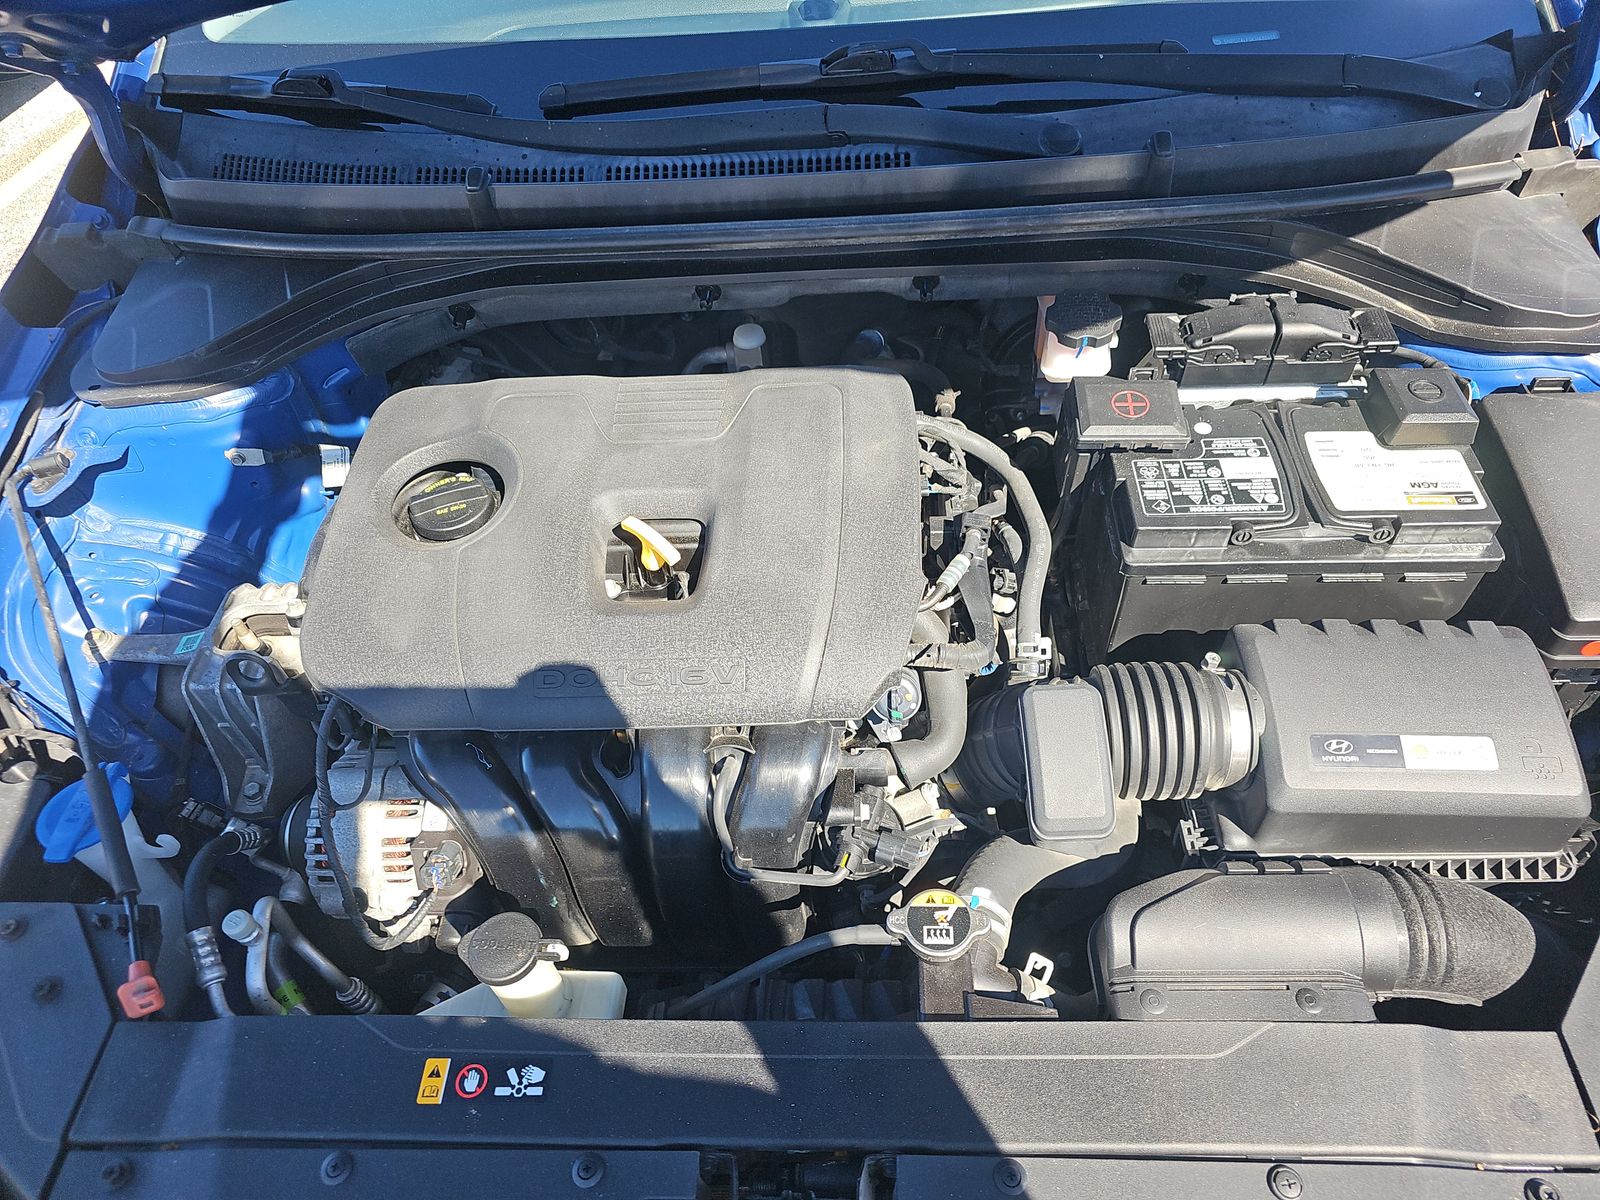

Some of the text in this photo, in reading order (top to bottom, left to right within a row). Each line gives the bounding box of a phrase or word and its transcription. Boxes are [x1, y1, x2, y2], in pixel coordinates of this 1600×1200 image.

[535, 664, 741, 689] DOHC 16V
[889, 914, 906, 925] HCC
